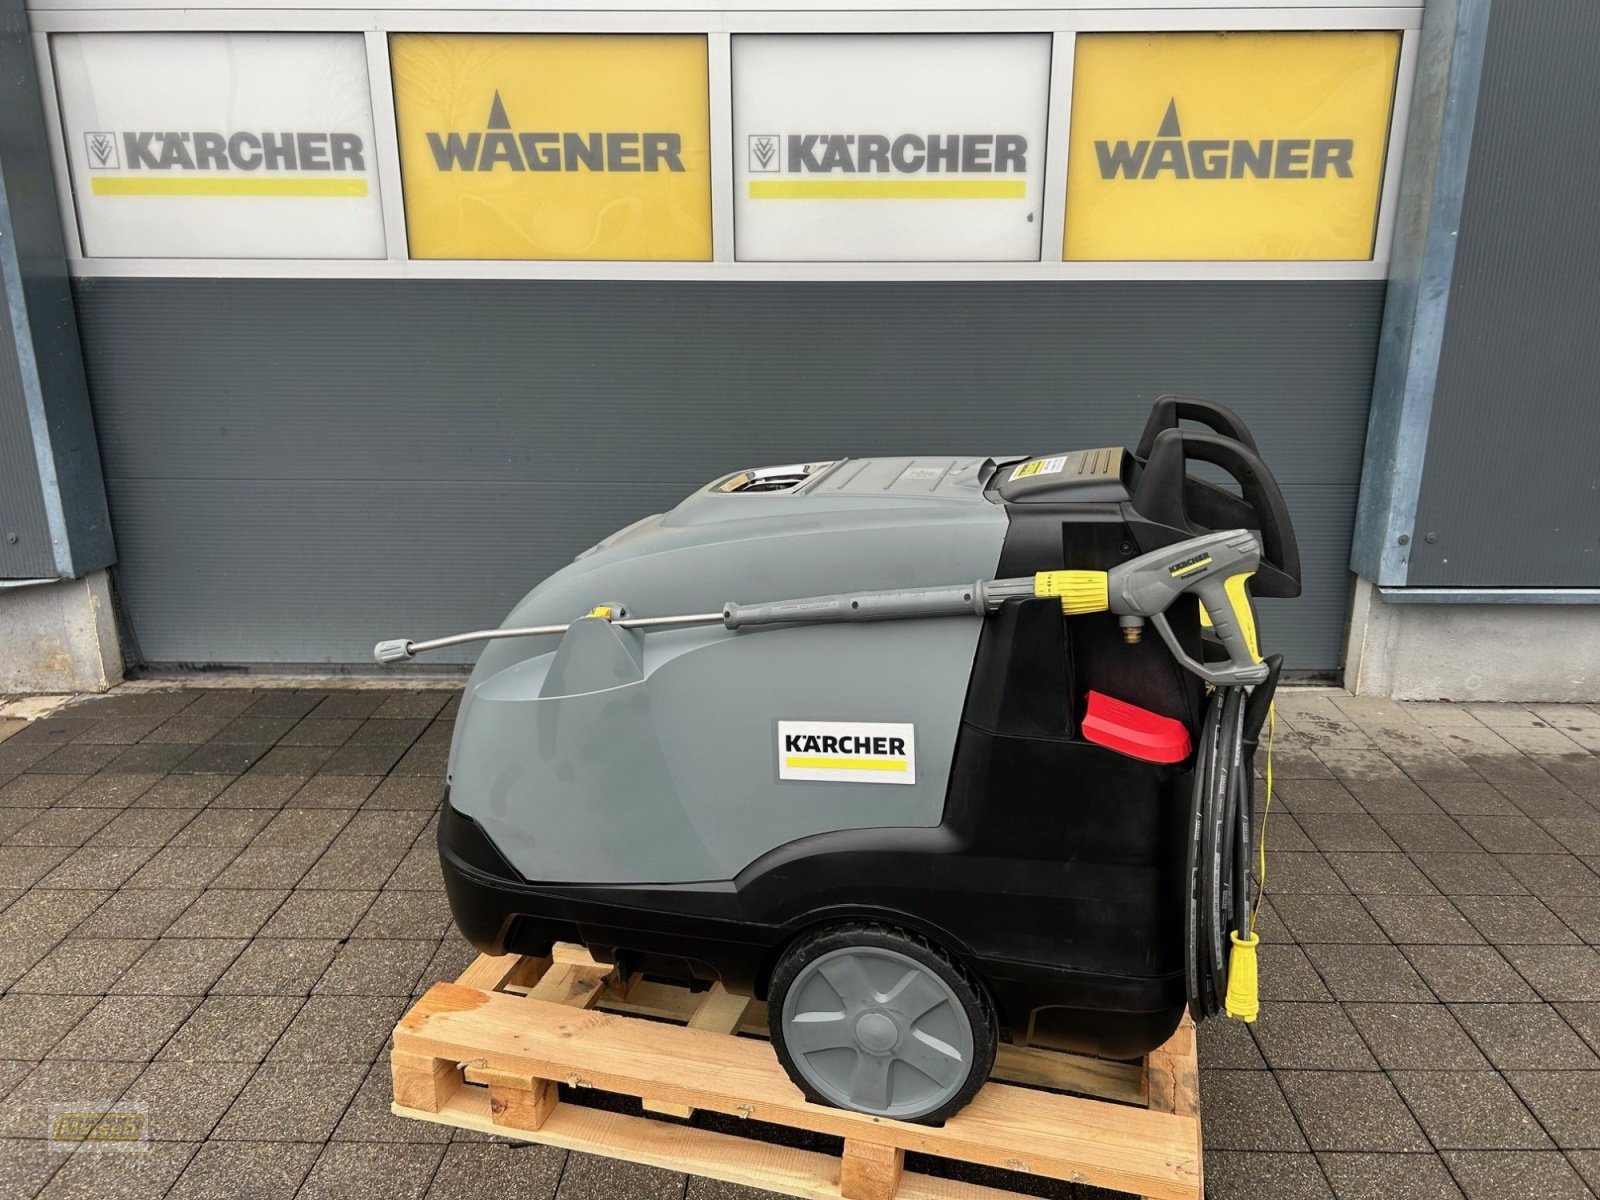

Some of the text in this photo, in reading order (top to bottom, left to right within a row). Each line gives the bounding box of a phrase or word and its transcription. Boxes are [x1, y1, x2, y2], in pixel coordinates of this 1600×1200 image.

[123, 131, 366, 171] KÄRCHER
[788, 133, 1027, 173] KÄRCHER
[785, 734, 906, 755] KÄRCHER
